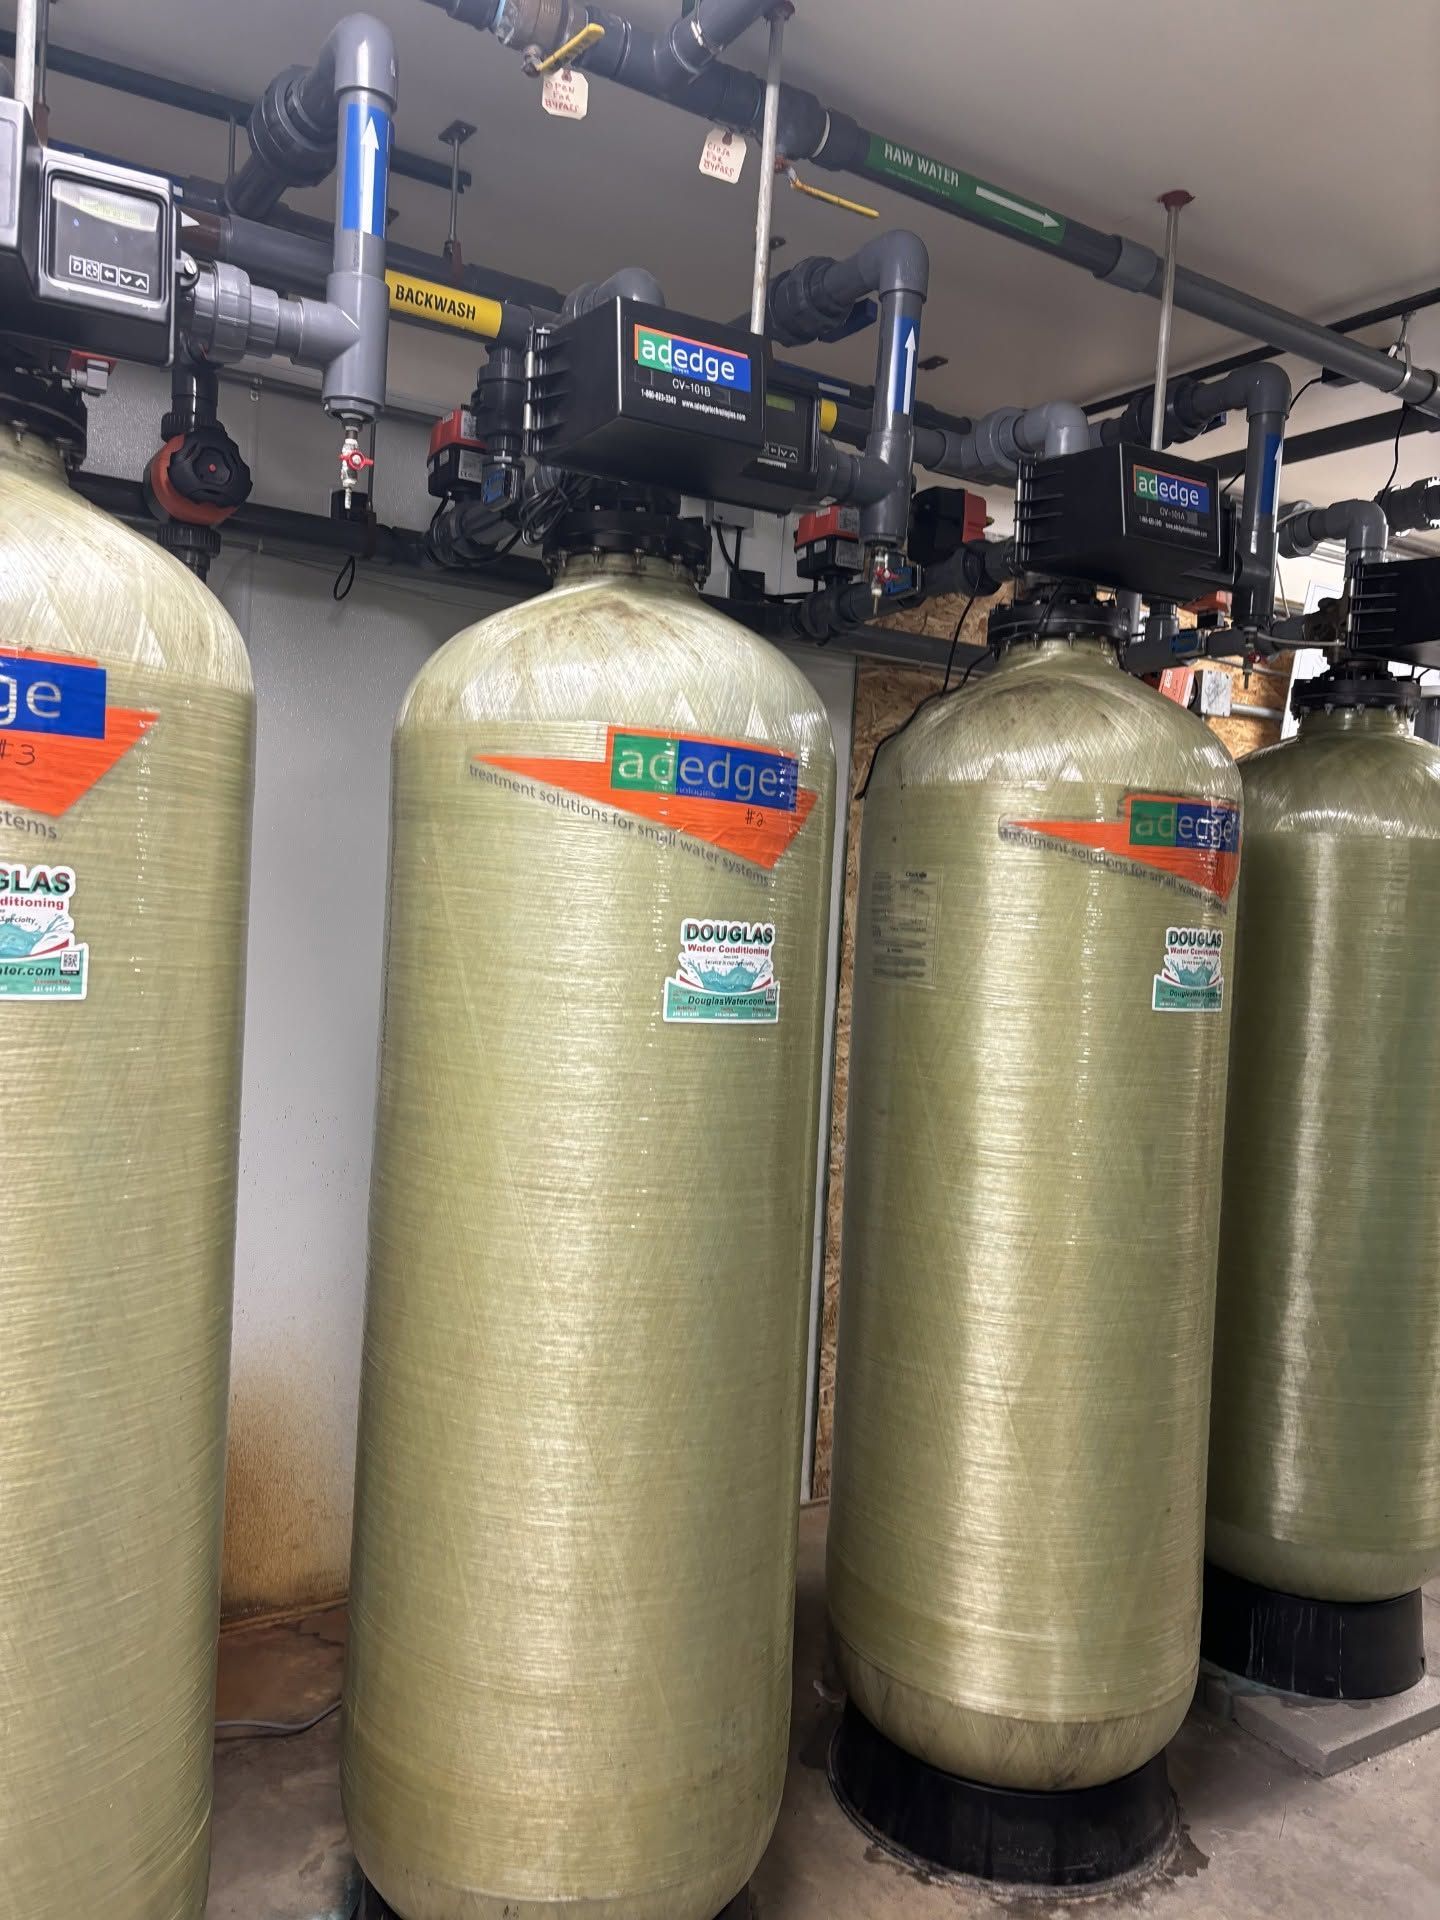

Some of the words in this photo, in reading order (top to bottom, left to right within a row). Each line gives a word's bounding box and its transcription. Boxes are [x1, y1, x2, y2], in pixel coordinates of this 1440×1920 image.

[884, 143, 914, 168] RAW
[917, 156, 960, 187] WATER
[395, 284, 477, 321] BACKWASH
[641, 339, 735, 382] adedge
[672, 379, 711, 397] CV-101B
[1138, 474, 1200, 508] adedge
[618, 748, 778, 801] adedge
[0, 809, 57, 840] tems
[469, 764, 536, 799] treatment
[540, 789, 609, 824] solutions
[611, 811, 635, 831] for
[637, 822, 677, 847] small
[680, 839, 720, 865] water
[721, 854, 769, 887] systems
[1135, 807, 1234, 848] adedge
[999, 828, 1067, 853] treatment
[1130, 861, 1148, 878] for
[685, 924, 773, 944] DOUGLAS
[688, 944, 716, 953] Water
[718, 945, 770, 957] Conditioning
[1168, 930, 1222, 947] DOUGLAS
[1170, 947, 1189, 955] Water
[688, 996, 763, 1006] DouglasWater.com
